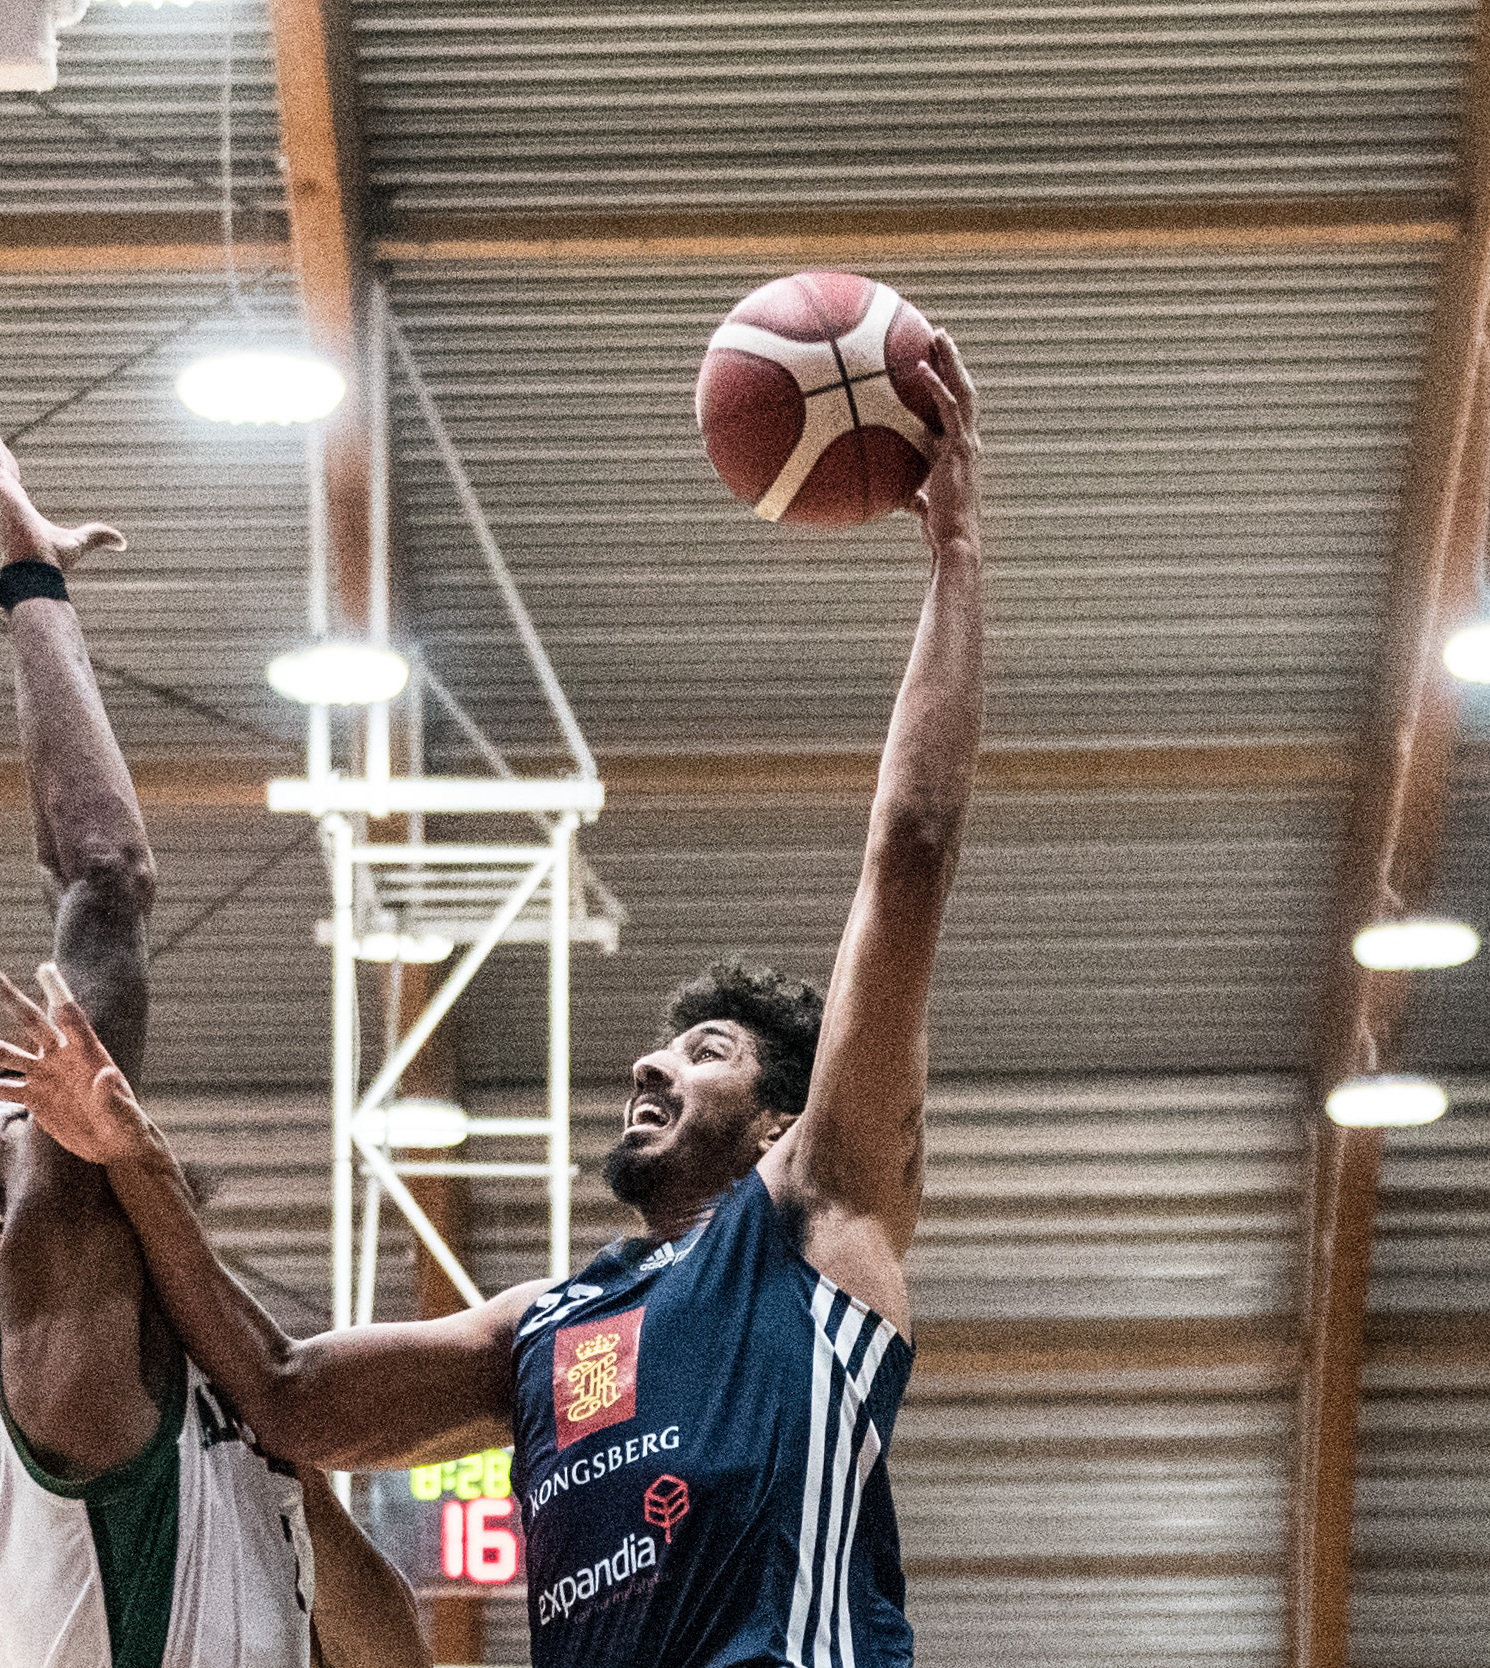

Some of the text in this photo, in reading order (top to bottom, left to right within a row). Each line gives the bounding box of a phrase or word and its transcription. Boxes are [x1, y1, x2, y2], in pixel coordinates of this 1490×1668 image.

[529, 1426, 680, 1517] KONGSBERG
[441, 1497, 518, 1583] 16
[539, 1533, 656, 1626] expandia
